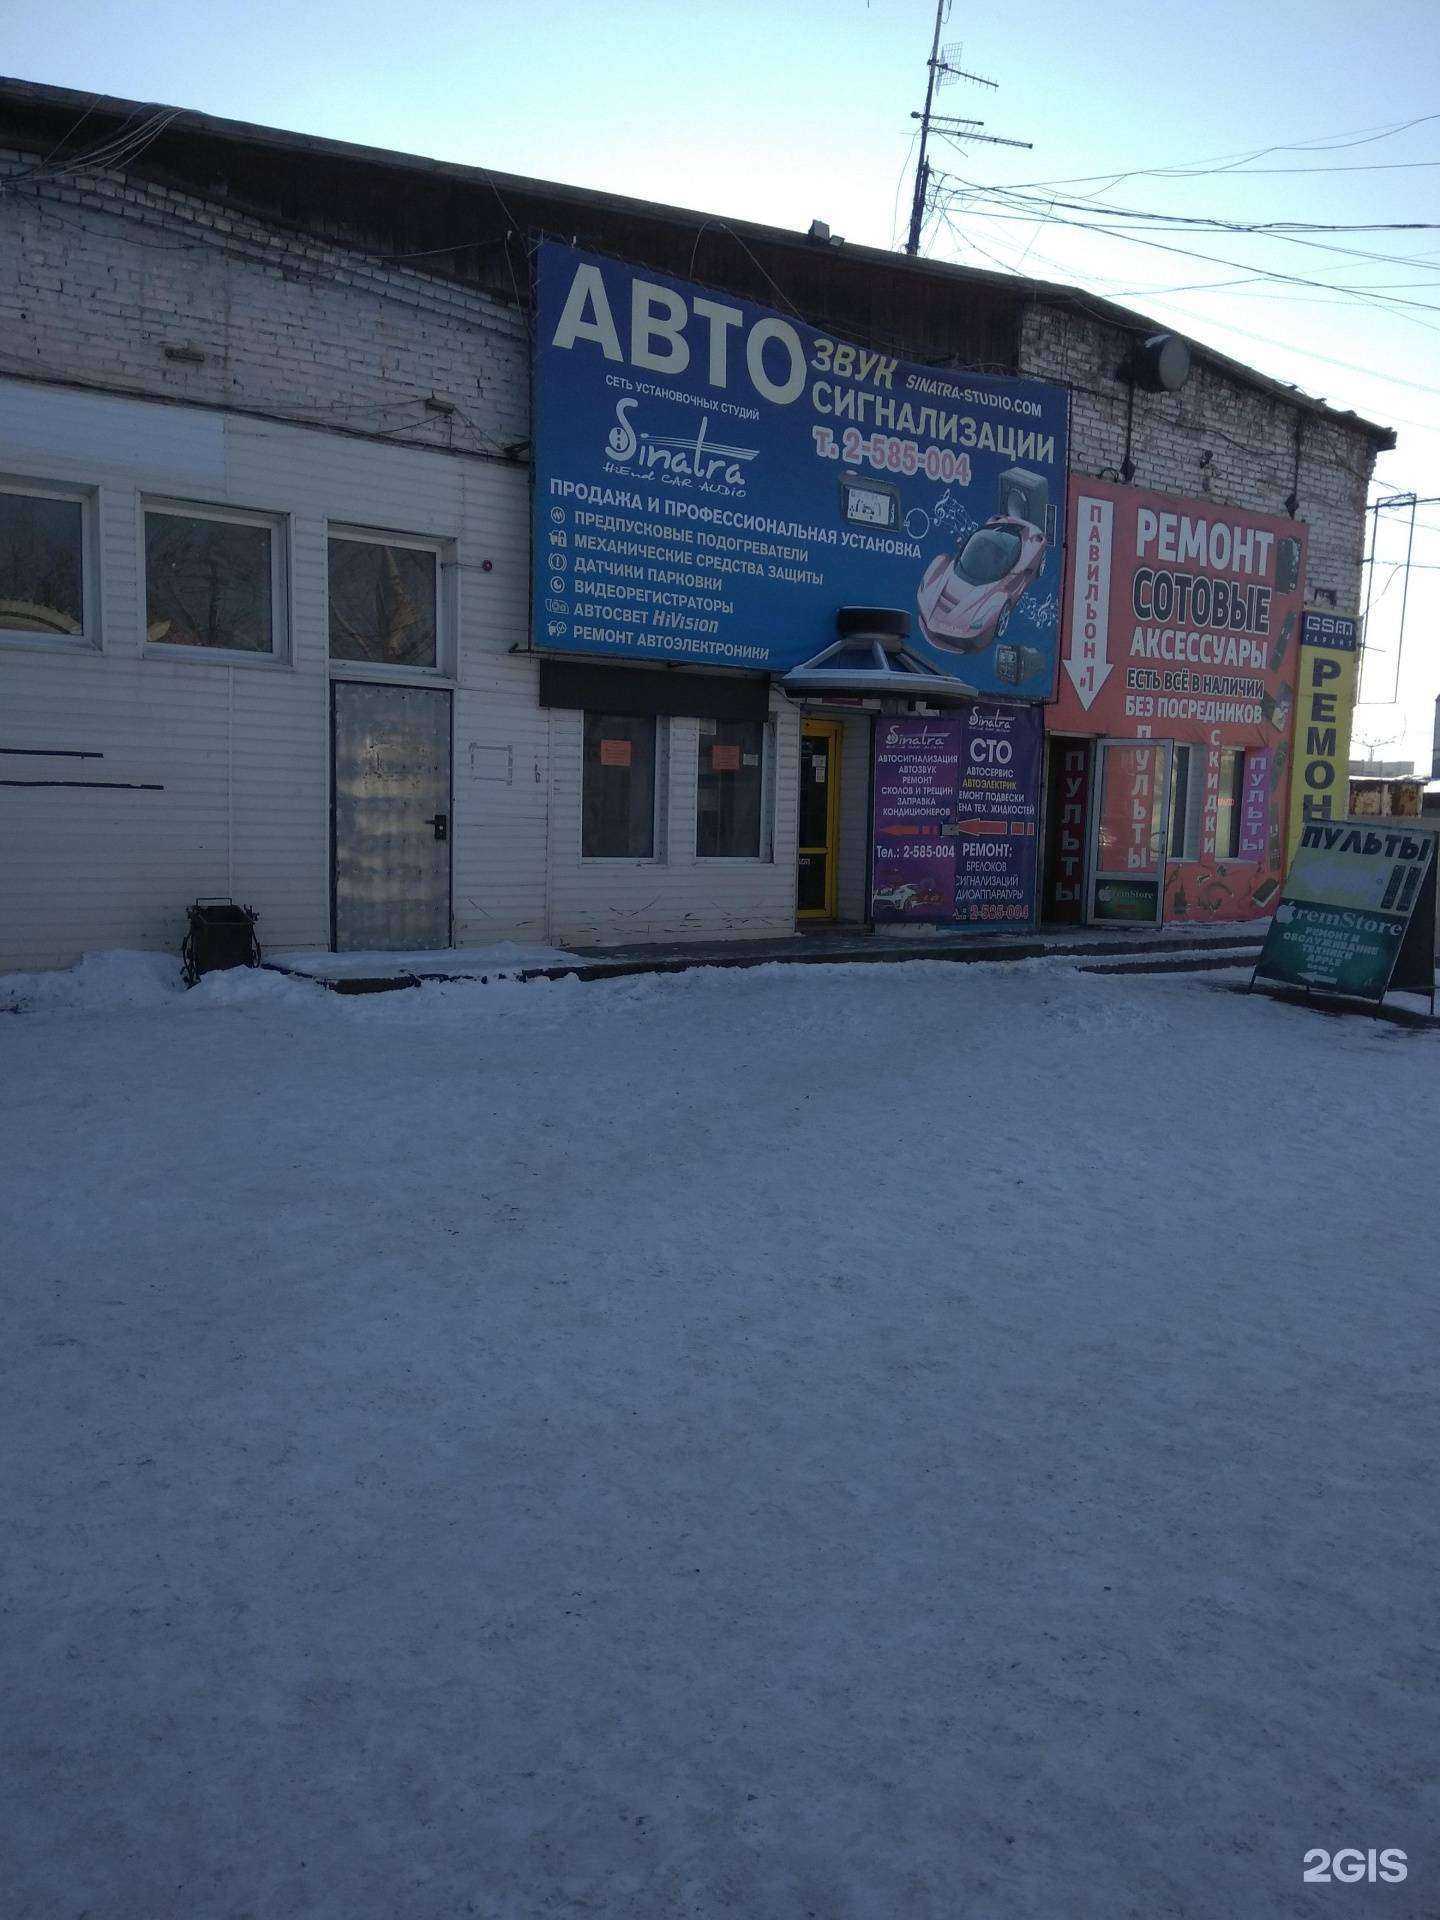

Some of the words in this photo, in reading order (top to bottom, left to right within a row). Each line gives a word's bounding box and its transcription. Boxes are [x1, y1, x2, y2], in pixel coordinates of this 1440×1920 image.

[552, 263, 807, 404] АВТО
[811, 338, 898, 390] ЗВУК
[605, 374, 634, 390] СЕТЬ
[635, 381, 719, 409] УСТАНОВОЧНЫХ
[721, 401, 760, 421] СТУДИЙ
[906, 374, 1042, 418] SINATRA-STUDIO.COM
[812, 380, 1054, 464] СИГНАЛИЗАЦИИ
[605, 398, 758, 485] Sinatra
[843, 427, 971, 486] 2-585-004
[550, 478, 642, 511] ПРОДАЖА
[648, 497, 660, 513] И
[664, 499, 837, 544] ПРОФЕССИОНАЛЬНАЯ
[841, 535, 921, 559] УСТАНОВКА
[574, 510, 693, 543] ПРЕДПУСКОВЫЕ
[697, 532, 809, 562] ПОДОГРЕВАТЕЛИ
[574, 534, 692, 565] МЕХАНИЧЕСКИЕ
[696, 554, 764, 577] СРЕДСТВА
[768, 565, 824, 585] ЗАЩИТЫ
[1136, 508, 1274, 576] РЕМОНТ
[574, 557, 644, 580] ДАТЧИКИ
[648, 568, 722, 592] ПАРКОВКИ
[1083, 504, 1102, 660] ПАВИЛЬОН
[574, 579, 734, 614] ВИДЕОРЕГИСТРАТОРЫ
[1132, 567, 1272, 636] СОТОВЫЕ
[573, 603, 648, 624] АВТОСВЕТ
[653, 609, 719, 634] HiVision
[1306, 616, 1353, 637] GSM
[574, 625, 633, 645] РЕМОНТ
[637, 633, 770, 661] АВТОЭЛЕКТРОНИКИ
[1129, 627, 1268, 670] АКСЕССУАРЫ
[1127, 668, 1161, 691] ЕСТЬ
[1164, 669, 1188, 692] ВСЁ
[1191, 677, 1200, 693] В
[1202, 678, 1264, 699] НАЛИЧИИ
[1125, 695, 1153, 717] БЕЗ
[1157, 697, 1262, 724] ПОСРЕДНИКОВ
[970, 738, 1012, 764] СТО
[1303, 657, 1341, 822] РЕМОН
[878, 754, 958, 764] АВТОСИГНАЛИЗАЦИЯ
[898, 765, 937, 774] АВТОЗВУК
[966, 766, 1014, 778] АВТОСЕРВИС
[881, 786, 914, 795] СКОЛОВ
[923, 787, 953, 797] ТРЕЩИН
[902, 776, 933, 784] РЕМОНТ
[958, 790, 984, 801] ЕМОНТ
[985, 791, 1024, 803] ПОДВЕСКИ
[962, 779, 1017, 790] АВТОЭЛЕКТРИК
[1203, 730, 1221, 853] СКИДКИ
[882, 808, 951, 818] КОНДИЦИОНЕРОВ
[897, 797, 936, 806] ЗАПРАВКА
[990, 804, 1035, 816] ЖИДКОСТЕЙ
[1055, 750, 1085, 901] ПУЛЬТЫ
[1301, 825, 1431, 861] ПУЛЬТЫ
[966, 861, 1007, 872] БРЕЛОКОВ
[955, 889, 1024, 902] ДИОАППАРАТУРЫ
